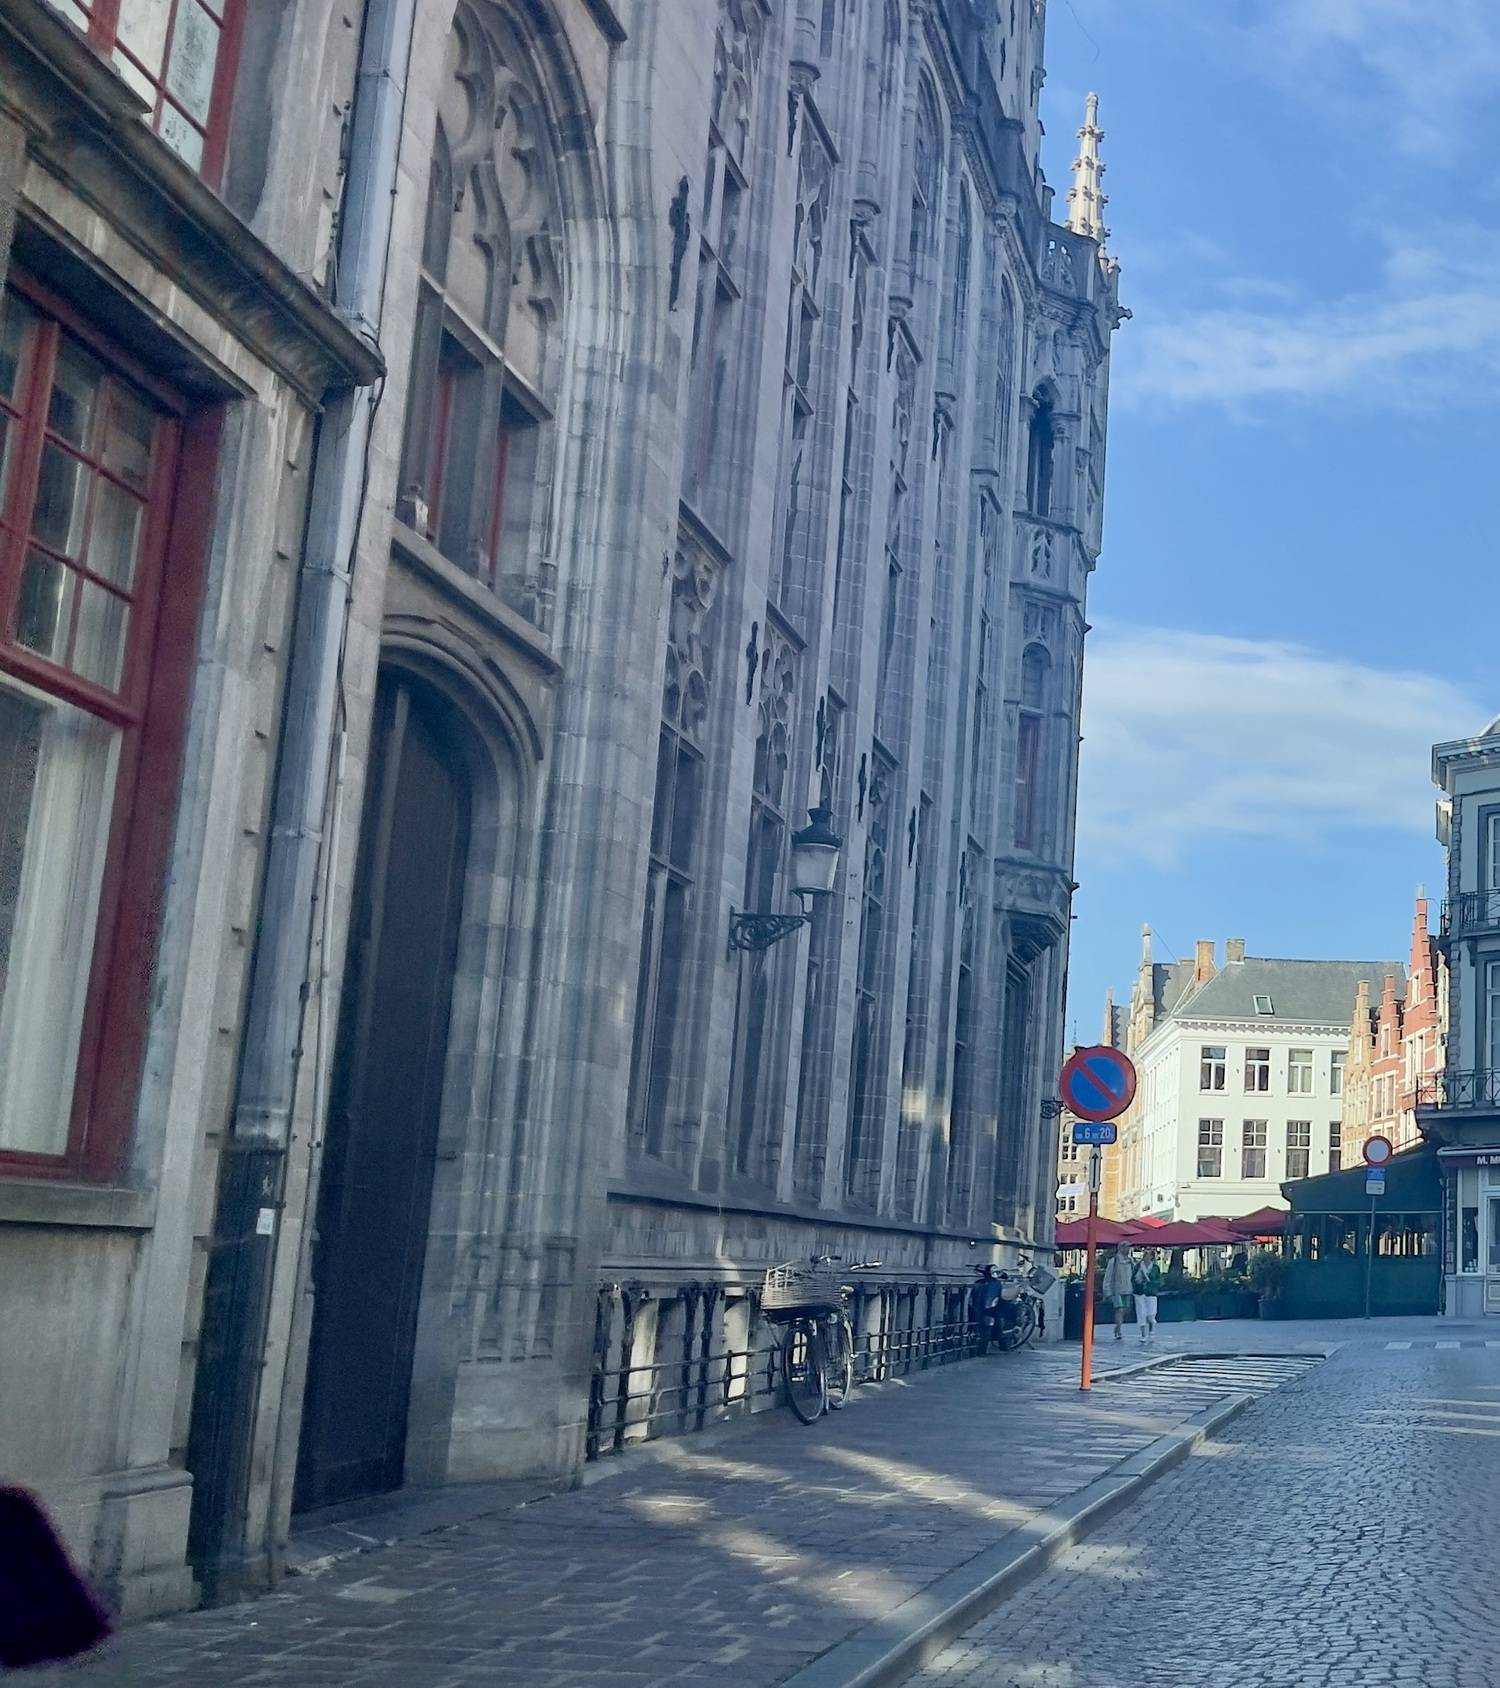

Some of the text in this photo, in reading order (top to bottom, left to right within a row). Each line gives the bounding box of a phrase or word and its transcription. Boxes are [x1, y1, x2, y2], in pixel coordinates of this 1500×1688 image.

[1084, 1127, 1091, 1139] 6
[1099, 1126, 1111, 1139] 20
[1476, 1155, 1488, 1165] M.
